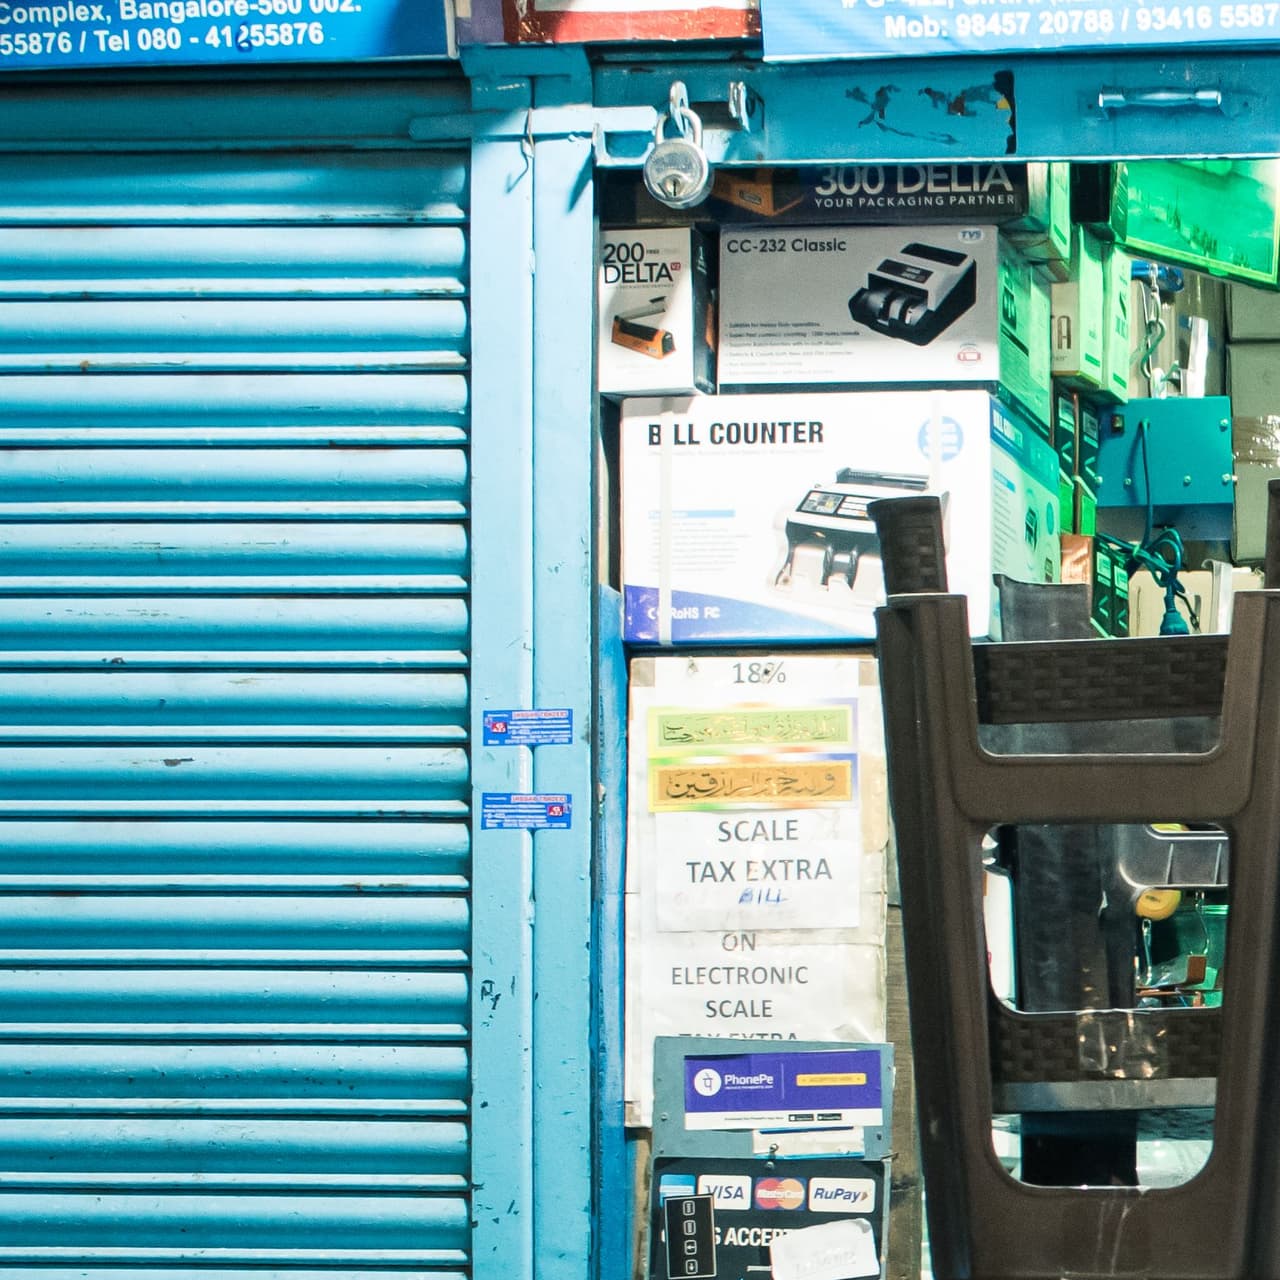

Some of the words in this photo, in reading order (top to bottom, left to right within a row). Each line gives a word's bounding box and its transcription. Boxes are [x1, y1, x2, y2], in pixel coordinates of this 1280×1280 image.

[884, 14, 949, 38] Mob:
[956, 11, 1031, 35] 98457
[1039, 9, 1114, 33] 20788
[1136, 5, 1212, 31] 93416
[94, 29, 130, 51] Tel
[137, 27, 181, 50] 080
[815, 165, 885, 196] 300
[897, 164, 1014, 194] DELTA
[814, 197, 854, 208] YOUR
[858, 195, 944, 207] PACKAGING
[949, 194, 1015, 205] PARTNER
[603, 242, 645, 263] 200
[726, 239, 786, 255] CC-232
[791, 237, 848, 254] Classic
[604, 262, 674, 284] DELTA
[648, 423, 701, 446] BLL
[708, 421, 825, 445] COUNTER
[732, 661, 787, 685] 18%
[718, 819, 799, 843] SCALE
[686, 861, 737, 884] TAX
[746, 858, 833, 882] EXTRA
[721, 932, 757, 952] ON
[670, 965, 809, 986] ELECTRONIC
[705, 999, 774, 1018] SCALE
[724, 1073, 774, 1086] PhonePe
[704, 1185, 745, 1200] VISA
[813, 1187, 862, 1202] RuPay
